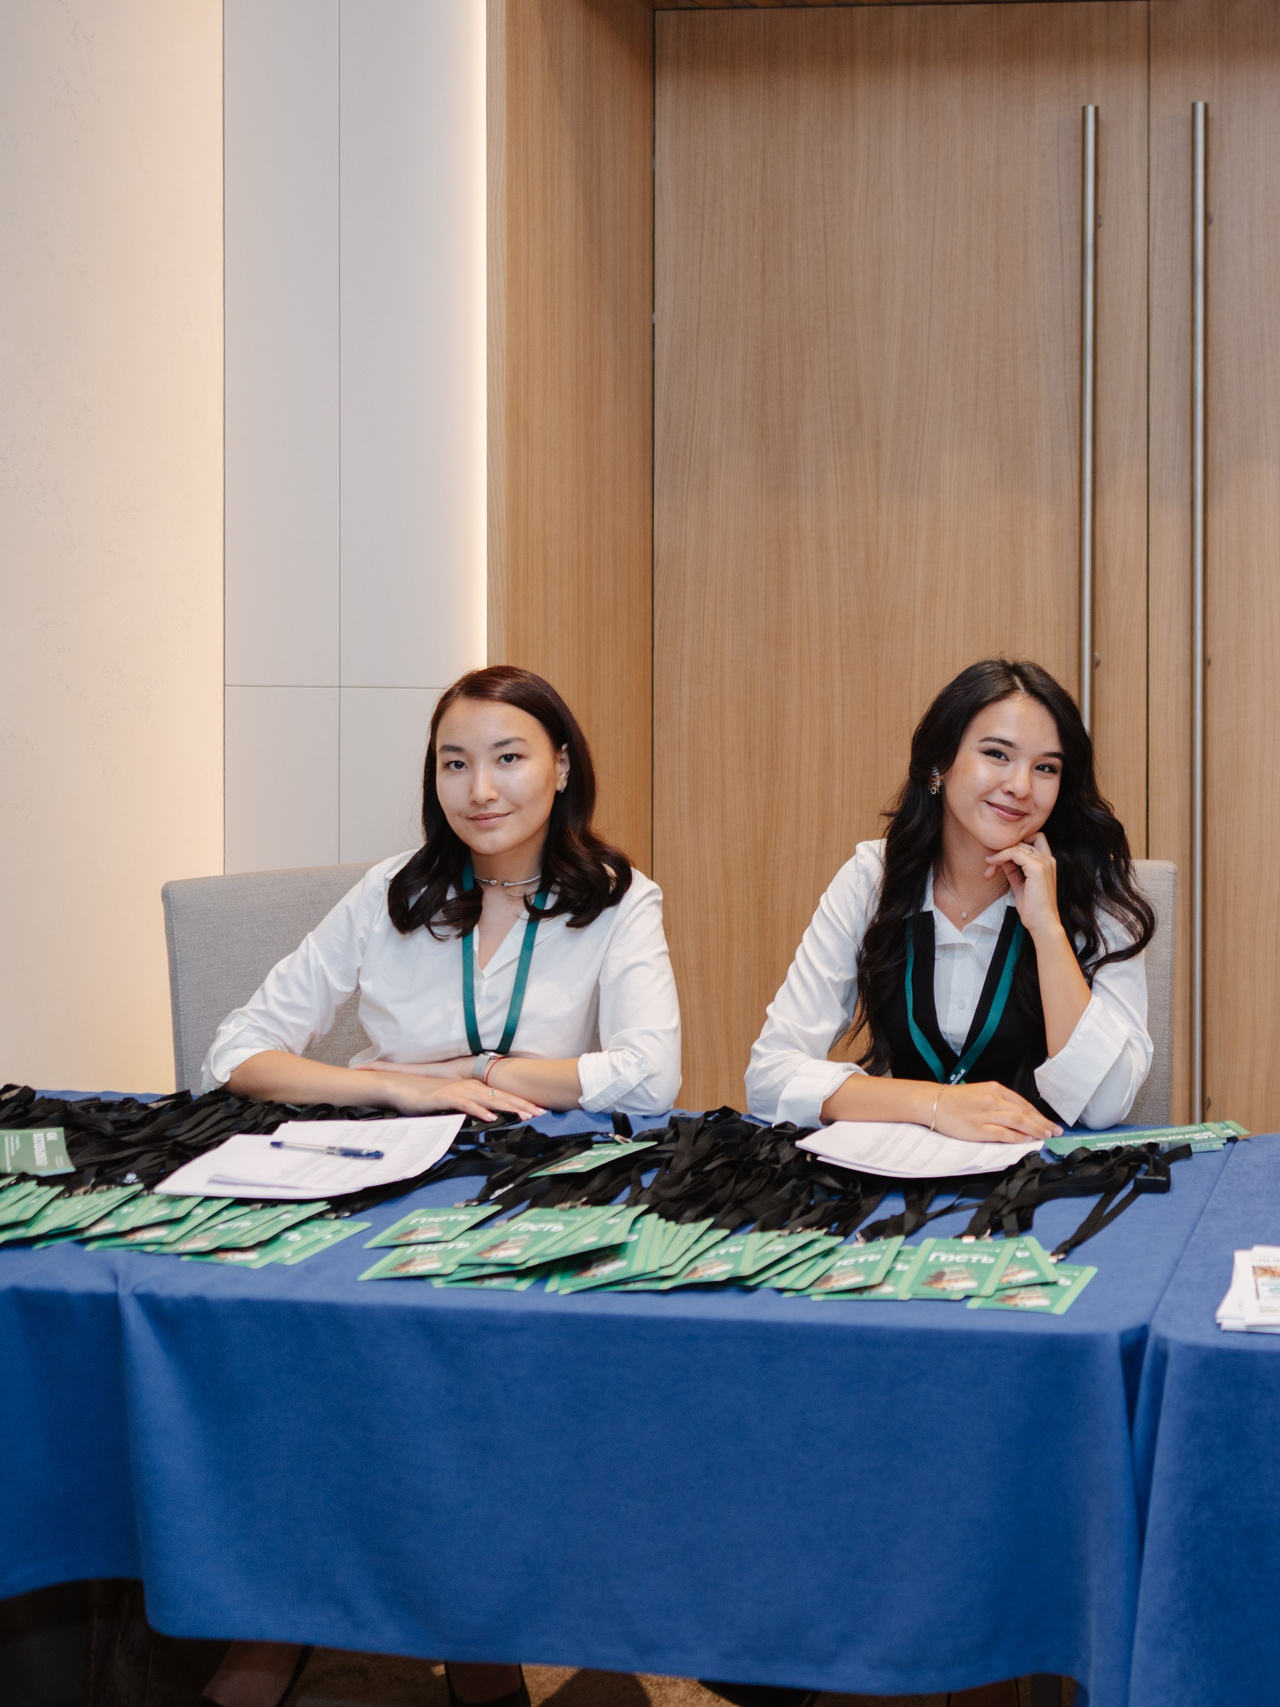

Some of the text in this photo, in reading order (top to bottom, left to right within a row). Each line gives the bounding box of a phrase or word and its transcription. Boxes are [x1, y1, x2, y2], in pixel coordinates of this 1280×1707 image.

[409, 1214, 471, 1225] Гость
[509, 1222, 566, 1232] Гость
[928, 1251, 996, 1265] Гость
